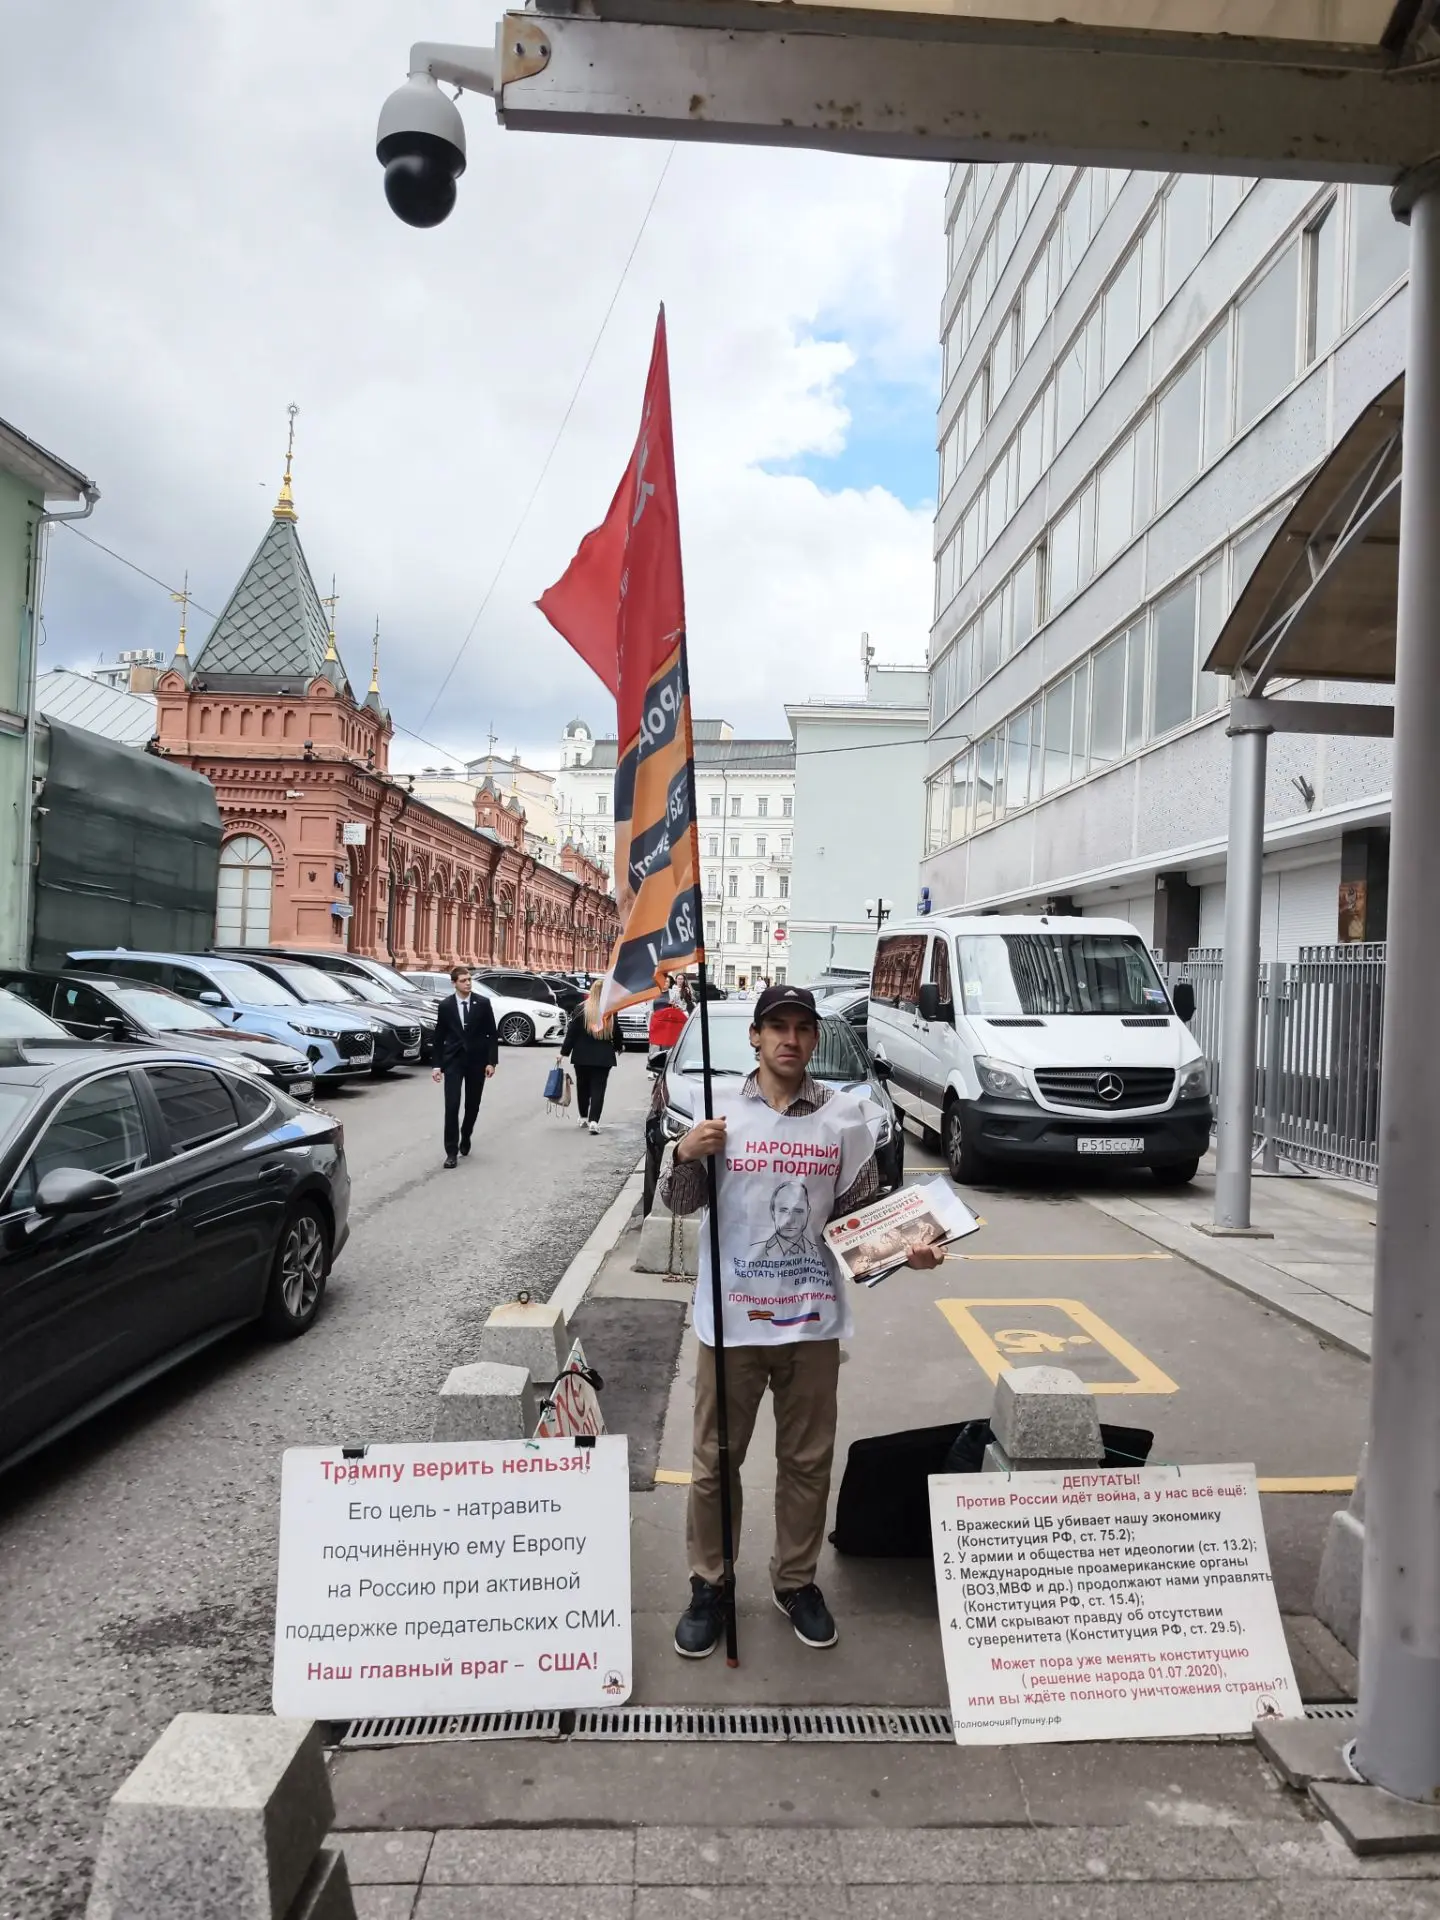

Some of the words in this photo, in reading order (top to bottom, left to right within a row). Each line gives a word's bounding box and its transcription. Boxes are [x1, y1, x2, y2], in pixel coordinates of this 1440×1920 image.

[745, 1141, 840, 1159] НАРОДНЫЙ
[748, 1258, 802, 1269] ПОДДЕРЖКИ
[320, 1461, 405, 1484] Трампу
[413, 1460, 494, 1480] верить
[503, 1452, 592, 1474] нельзя!
[1063, 1474, 1140, 1490] ДЕПУТАТЫ!
[957, 1496, 1005, 1510] Против
[1010, 1494, 1058, 1505] России
[1062, 1492, 1092, 1505] идёт
[1097, 1490, 1139, 1502] война,
[1144, 1491, 1150, 1500] а
[1154, 1491, 1161, 1502] у
[1166, 1490, 1188, 1499] нас
[1192, 1486, 1213, 1497] всё
[1217, 1485, 1246, 1497] ещё:
[349, 1502, 382, 1520] Его
[390, 1504, 436, 1522] цель
[458, 1500, 561, 1520] натравить
[941, 1520, 952, 1532] 1.
[957, 1517, 1030, 1534] Вражеский
[1034, 1516, 1053, 1530] ЦБ
[1057, 1515, 1111, 1530] убивает
[1114, 1514, 1148, 1526] нашу
[1152, 1511, 1221, 1523] экономику
[323, 1540, 460, 1562] подчинённую
[467, 1540, 505, 1558] ему
[513, 1534, 586, 1556] Европу
[943, 1552, 955, 1564] 2.
[958, 1551, 966, 1563] У
[971, 1552, 1013, 1565] армии
[1018, 1552, 1025, 1560] и
[1030, 1548, 1094, 1561] общества
[1098, 1548, 1120, 1557] нет
[1125, 1544, 1195, 1557] идеологии
[1199, 1540, 1219, 1555] (ст.
[1223, 1538, 1257, 1552] 13.2);
[957, 1534, 1048, 1550] (Конституция
[1052, 1531, 1076, 1544] РФ,
[1080, 1532, 1096, 1542] ст.
[1100, 1528, 1135, 1543] 75.2);
[945, 1568, 956, 1580] 3.
[960, 1566, 1074, 1582] Международные
[1078, 1560, 1196, 1576] проамериканские
[1200, 1557, 1248, 1571] органы
[328, 1584, 351, 1598] на
[360, 1579, 435, 1597] Россию
[443, 1580, 478, 1599] при
[486, 1571, 580, 1593] активной
[962, 1581, 1032, 1599] (ВОЗ,МВФ
[1036, 1584, 1044, 1592] и
[1048, 1579, 1073, 1595] др.)
[1077, 1577, 1162, 1593] продолжают
[1166, 1576, 1199, 1586] нами
[1203, 1572, 1273, 1587] управлять
[964, 1599, 1056, 1616] (Конституция
[1060, 1596, 1084, 1609] РФ,
[1088, 1597, 1105, 1606] ст.
[1109, 1592, 1144, 1607] 15.4);
[286, 1622, 397, 1642] поддержке
[405, 1616, 558, 1640] предательских
[566, 1609, 620, 1629] СМИ.
[950, 1618, 961, 1630] 4.
[965, 1616, 997, 1629] СМИ
[1001, 1615, 1070, 1630] скрывают
[1074, 1612, 1122, 1626] правду
[1127, 1608, 1143, 1621] об
[1148, 1607, 1223, 1622] отсутствии
[968, 1632, 1062, 1648] суверенитета
[1066, 1627, 1158, 1644] (Конституция
[1161, 1623, 1186, 1637] РФ,
[1190, 1625, 1207, 1634] ст.
[1210, 1620, 1245, 1635] 29.5).
[308, 1662, 352, 1680] Наш
[360, 1657, 453, 1679] главный
[461, 1660, 508, 1679] враг
[539, 1652, 597, 1672] США!
[991, 1658, 1035, 1670] Может
[1040, 1657, 1073, 1670] пора
[1077, 1656, 1102, 1669] уже
[1107, 1653, 1156, 1664] менять
[1160, 1648, 1249, 1662] конституцию
[969, 1696, 994, 1706] или
[999, 1695, 1019, 1704] вы
[1024, 1690, 1065, 1704] ждёте
[1070, 1689, 1127, 1700] полного
[1130, 1684, 1221, 1700] уничтожения
[1225, 1678, 1288, 1698] страны?!
[1031, 1674, 1091, 1688] решение
[1095, 1671, 1145, 1684] народа
